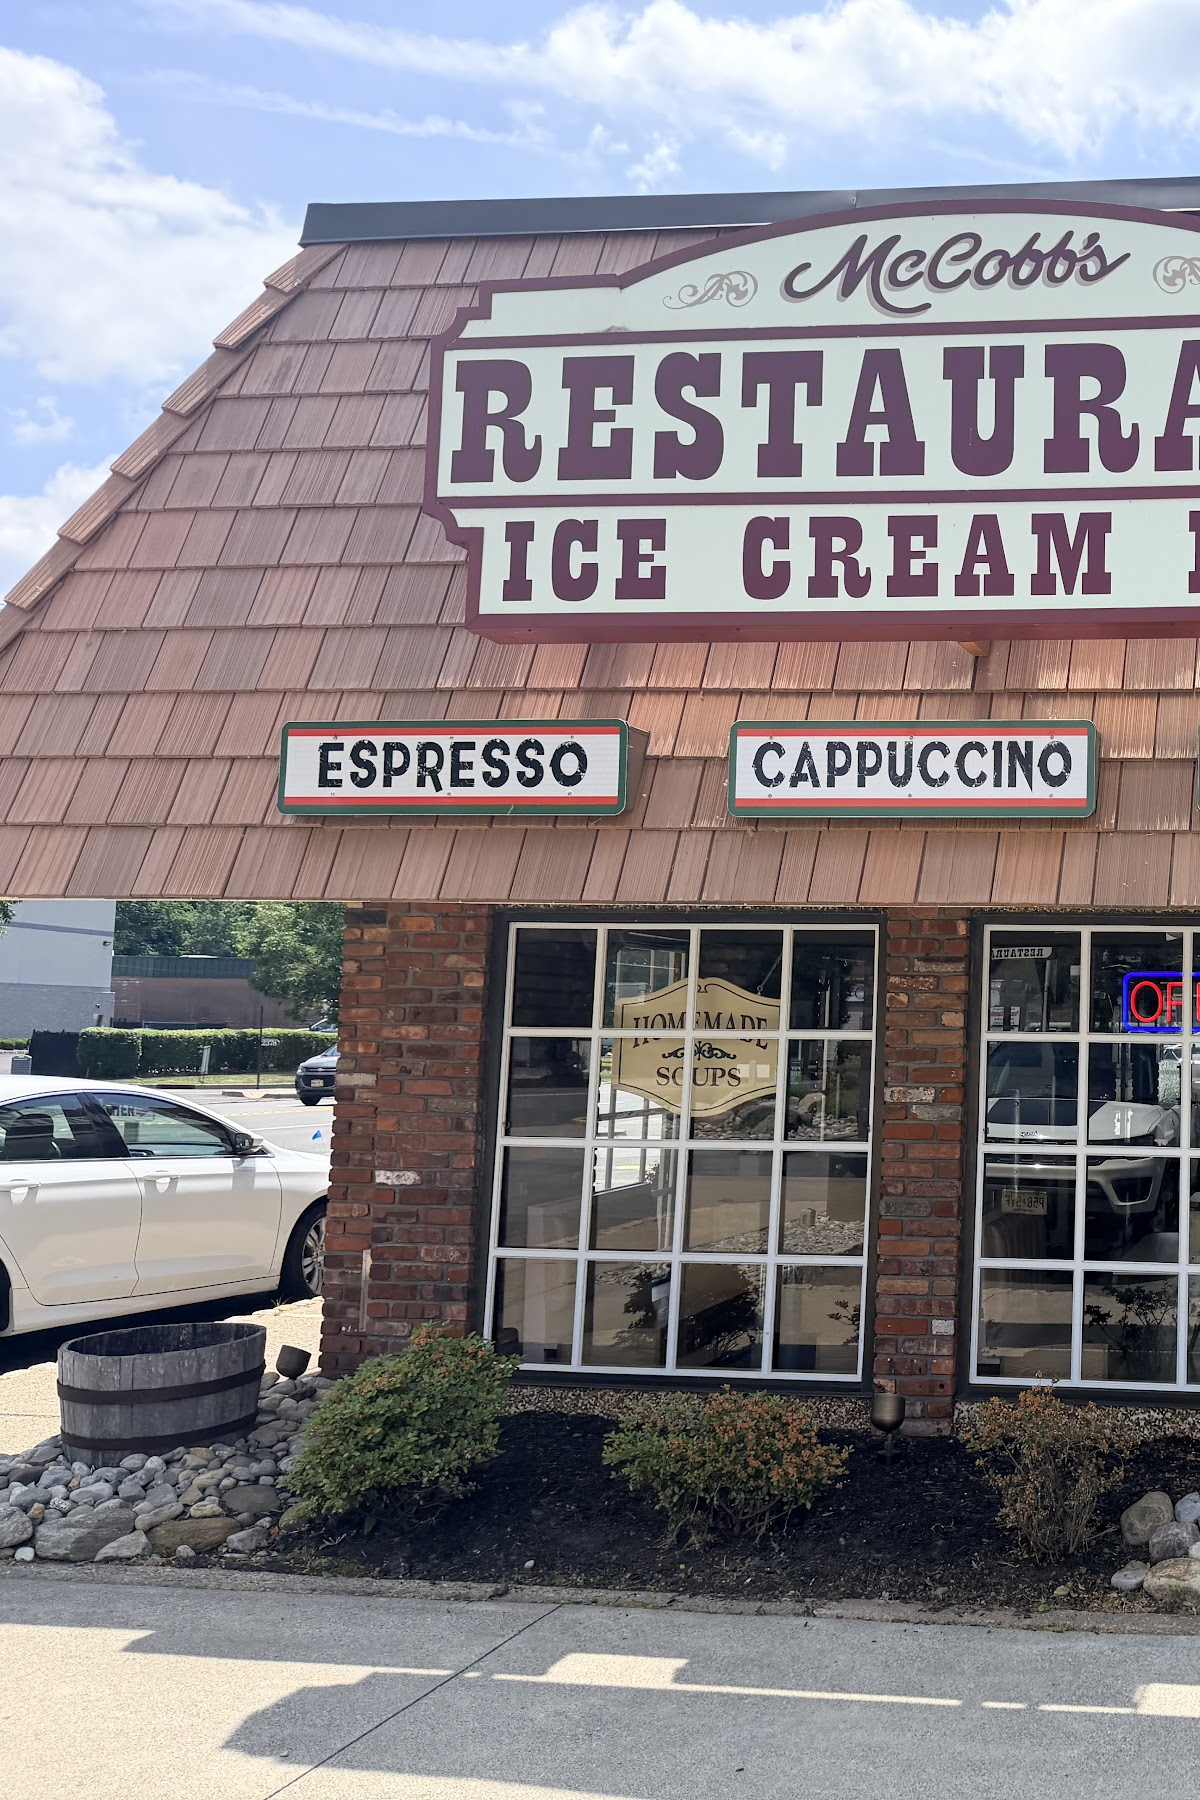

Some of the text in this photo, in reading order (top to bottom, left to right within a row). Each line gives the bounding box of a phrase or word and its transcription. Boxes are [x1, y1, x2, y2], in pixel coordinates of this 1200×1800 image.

[781, 230, 1131, 317] McCobb's
[502, 518, 667, 602] ICE
[742, 511, 1112, 600] CREAM
[318, 738, 588, 793] ESPRESSO
[752, 740, 1072, 792] CAPPUCCINO
